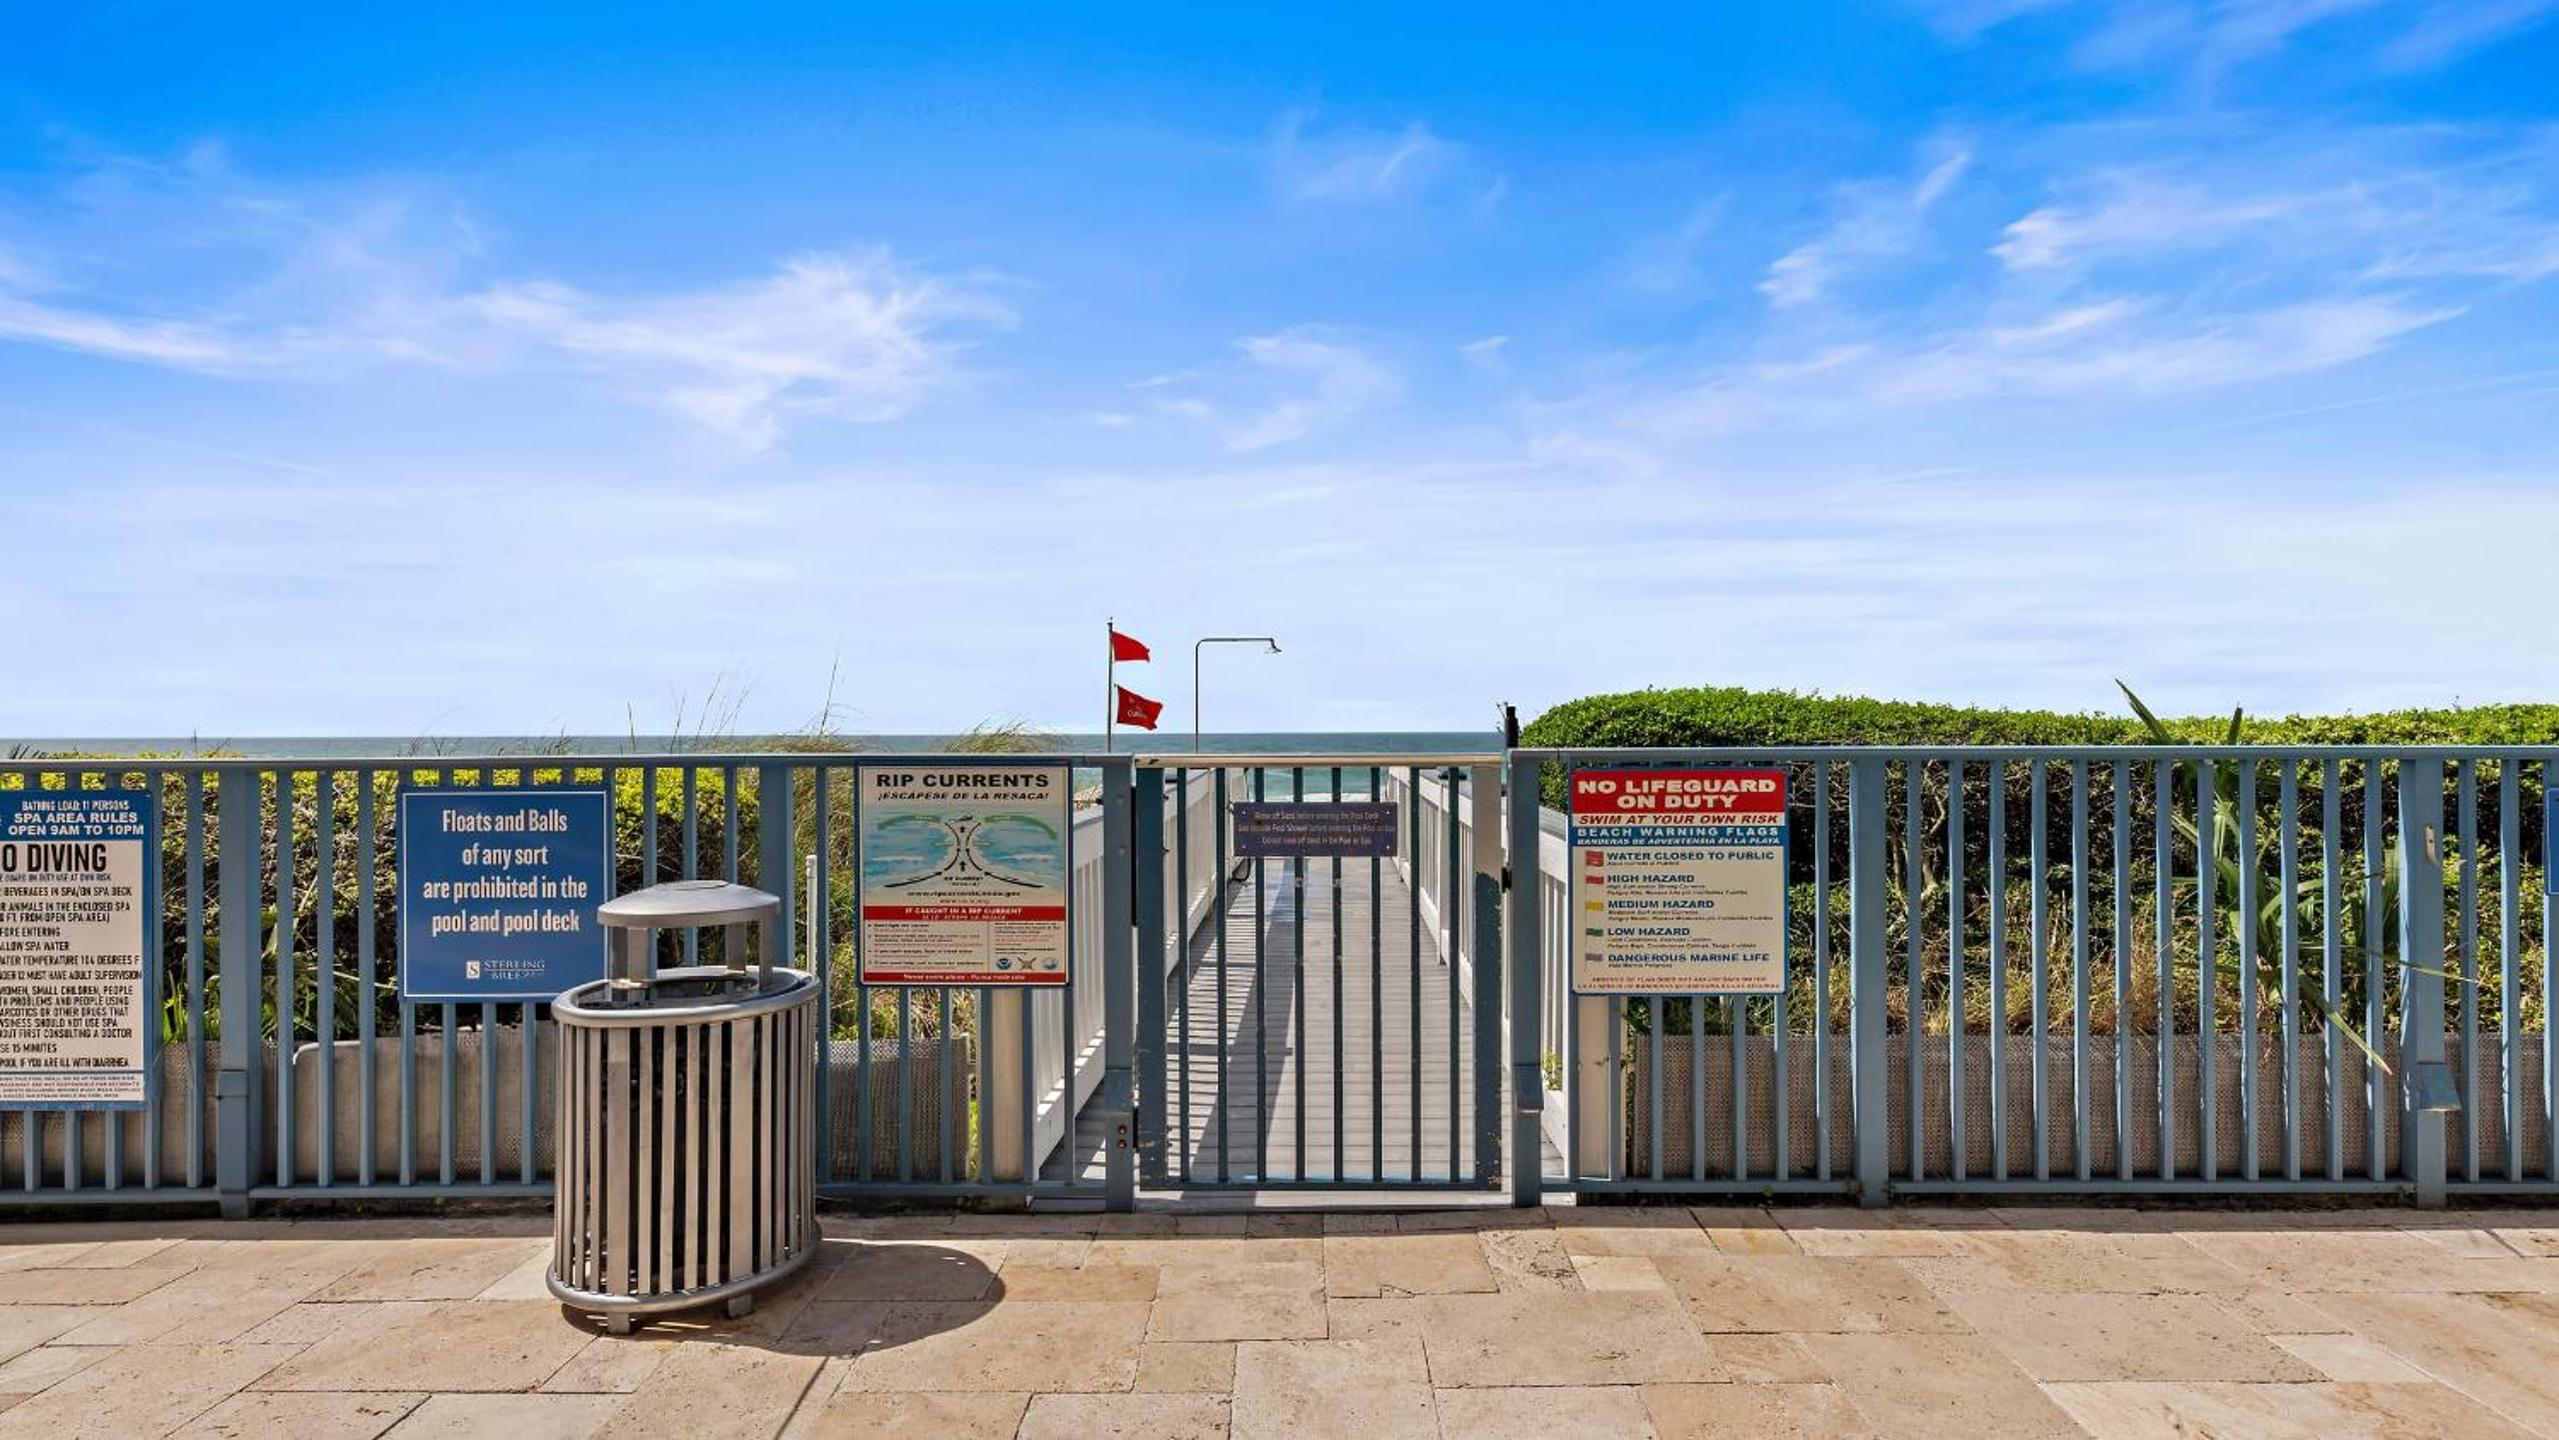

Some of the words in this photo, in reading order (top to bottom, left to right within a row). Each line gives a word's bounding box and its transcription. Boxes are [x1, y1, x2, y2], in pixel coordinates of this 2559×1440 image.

[876, 774, 914, 787] RIP
[923, 774, 1049, 787] CURRENTS
[1578, 780, 1617, 794] NO
[1625, 780, 1776, 794] LIFEGUARD
[953, 792, 969, 800] DE
[973, 792, 989, 800] LA
[22, 800, 56, 811] BATHING
[92, 800, 129, 811] PERSONS
[1617, 795, 1656, 808] ON
[1664, 795, 1739, 808] DUTY
[14, 812, 42, 823] SPA
[46, 812, 85, 823] AREA
[90, 812, 137, 823] RULES
[442, 810, 492, 832] Floats
[495, 809, 524, 832] and
[529, 809, 567, 832] Balls
[1579, 815, 1622, 825] SWIM
[1626, 815, 1648, 825] AT
[1653, 815, 1694, 825] YOUR
[1700, 815, 1733, 825] OWN
[1740, 815, 1777, 825] RISK
[8, 824, 46, 835] OPEN
[51, 824, 80, 835] 9AM
[84, 824, 103, 835] TO
[107, 824, 144, 835] 10PM
[1577, 828, 1632, 837] BEACH
[1640, 828, 1718, 837] WARNING
[1726, 828, 1778, 837] FLAGS
[27, 843, 107, 872] DIVING
[462, 843, 479, 865] of
[482, 848, 512, 870] any
[515, 846, 548, 865] sort
[1607, 852, 1650, 860] WATER
[1654, 852, 1704, 860] CLOSED
[1708, 852, 1724, 860] TO
[1728, 852, 1774, 860] PUBLIC
[1608, 875, 1639, 883] HIGH
[1643, 875, 1695, 883] HAZARD
[3, 886, 48, 897] BEVERAGES
[51, 886, 58, 897] IN
[94, 886, 109, 897] SPA
[112, 886, 132, 897] DECK
[423, 881, 450, 898] are
[453, 876, 538, 903] prohibited
[542, 876, 556, 898] in
[561, 876, 587, 898] the
[9, 902, 43, 911] ANIMALS
[46, 902, 53, 911] IN
[56, 902, 70, 911] THE
[73, 902, 113, 911] ENCLOSED
[116, 902, 130, 911] SPA
[20, 913, 42, 922] FROM
[45, 913, 65, 922] OPEN
[68, 913, 82, 922] SPA
[432, 910, 466, 937] pool
[470, 910, 499, 931] and
[504, 910, 538, 937] pool
[542, 910, 579, 931] deck
[22, 928, 60, 937] ENTERING
[1608, 928, 1635, 936] LOW
[1639, 928, 1690, 936] HAZARD
[25, 941, 41, 951] SPA
[44, 941, 69, 951] WATER
[23, 955, 78, 965] TEMPERATURE
[97, 955, 132, 965] DEGREES
[1608, 954, 1686, 962] DANGEROUS
[1690, 954, 1739, 962] MARINE
[1743, 954, 1770, 962] LIFE
[27, 971, 46, 980] MUST
[49, 971, 67, 980] HAVE
[70, 971, 91, 980] ADULT
[95, 971, 142, 980] SUPERVISION
[32, 986, 58, 995] SMALL
[104, 986, 133, 995] PEOPLE
[10, 996, 52, 1005] PROBLEMS
[56, 996, 71, 1005] AND
[74, 996, 102, 1005] PEOPLE
[106, 996, 129, 1005] USING
[54, 1008, 79, 1017] OTHER
[82, 1008, 106, 1017] DRUGS
[110, 1008, 128, 1017] THAT
[35, 1018, 65, 1027] SHOULD
[68, 1018, 83, 1027] NOT
[85, 1018, 99, 1027] USE
[102, 1018, 117, 1027] SPA
[20, 1029, 40, 1038] FIRST
[44, 1029, 91, 1038] CONSULTING
[102, 1029, 132, 1038] DOCTOR
[12, 1044, 21, 1053] 15
[23, 1044, 57, 1053] MINUTES
[73, 1058, 90, 1067] WITH
